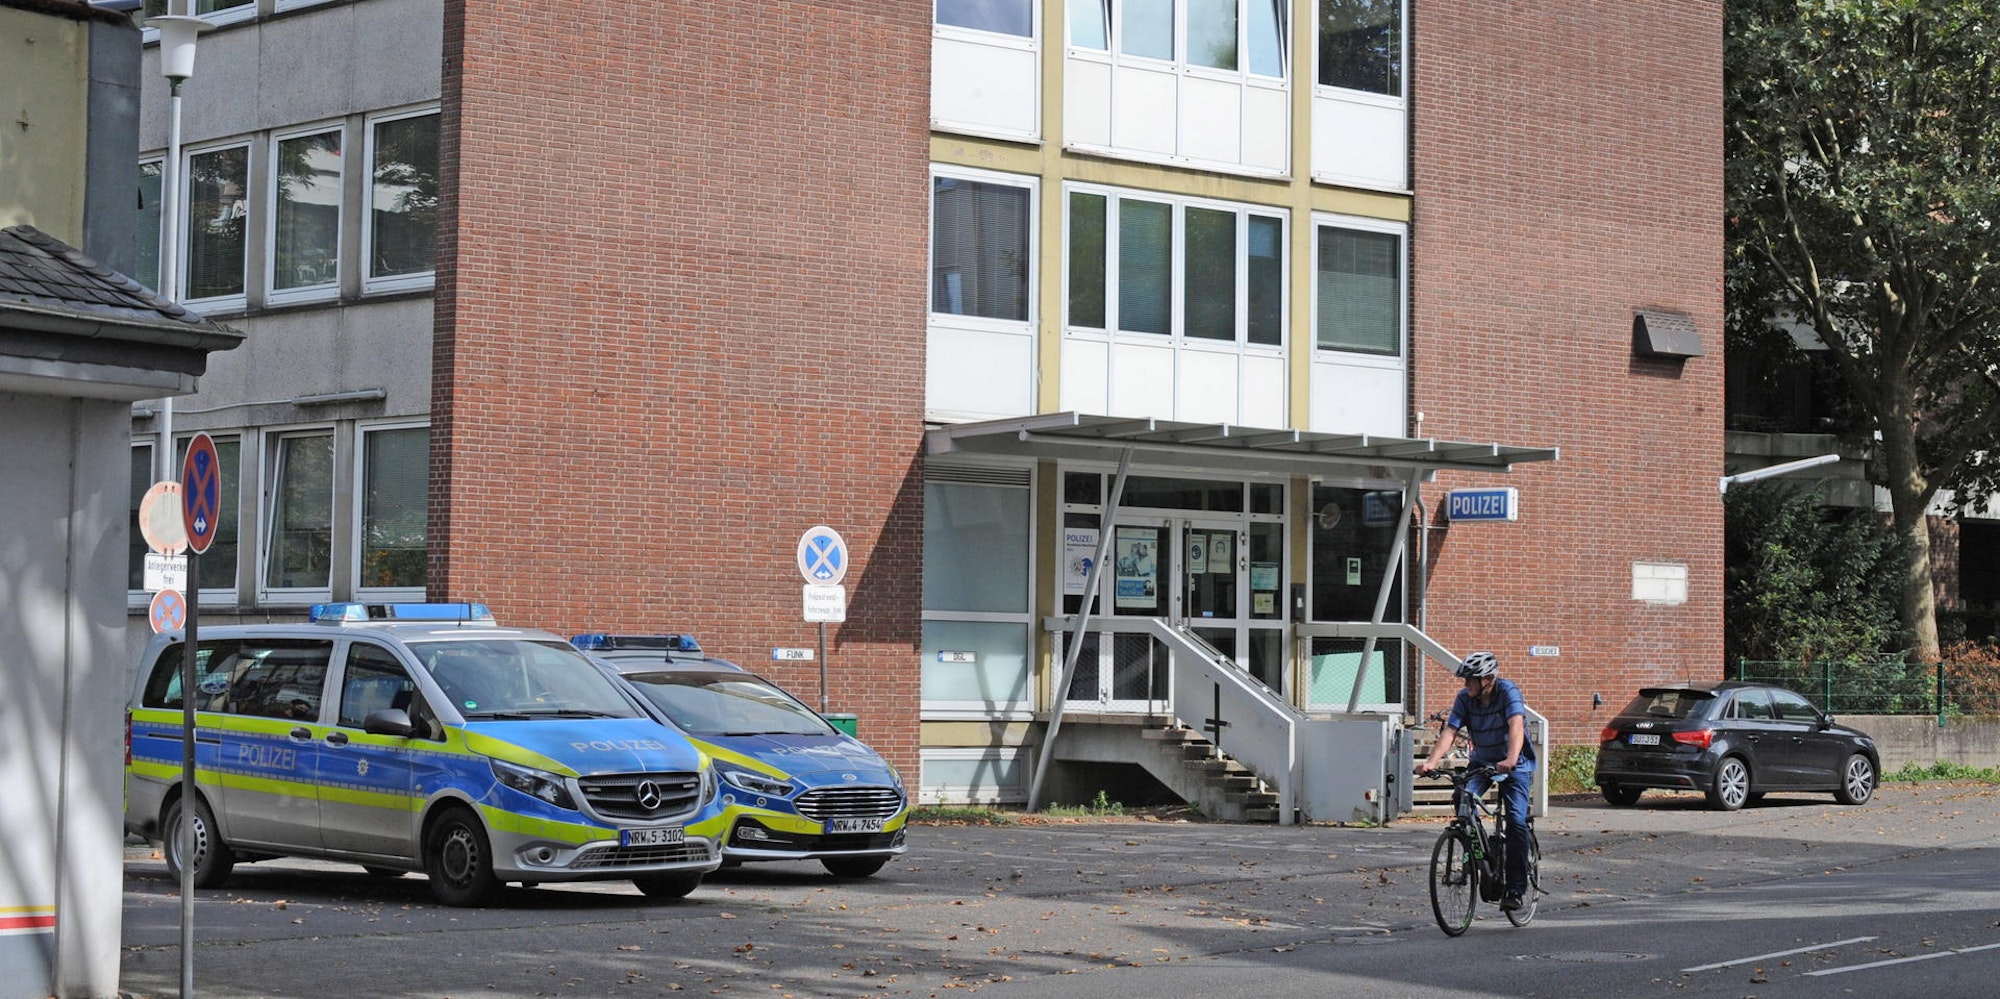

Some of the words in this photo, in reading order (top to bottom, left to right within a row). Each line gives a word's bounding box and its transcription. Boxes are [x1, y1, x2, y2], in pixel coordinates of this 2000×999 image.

[1453, 495, 1505, 515] POLIZEI
[1066, 534, 1093, 543] POLIZEI
[163, 574, 175, 585] frei
[786, 650, 804, 658] FUNK
[570, 738, 667, 752] POLIZEI
[239, 743, 297, 770] POLIZEI
[832, 819, 848, 831] NRW
[628, 831, 647, 844] NRW
